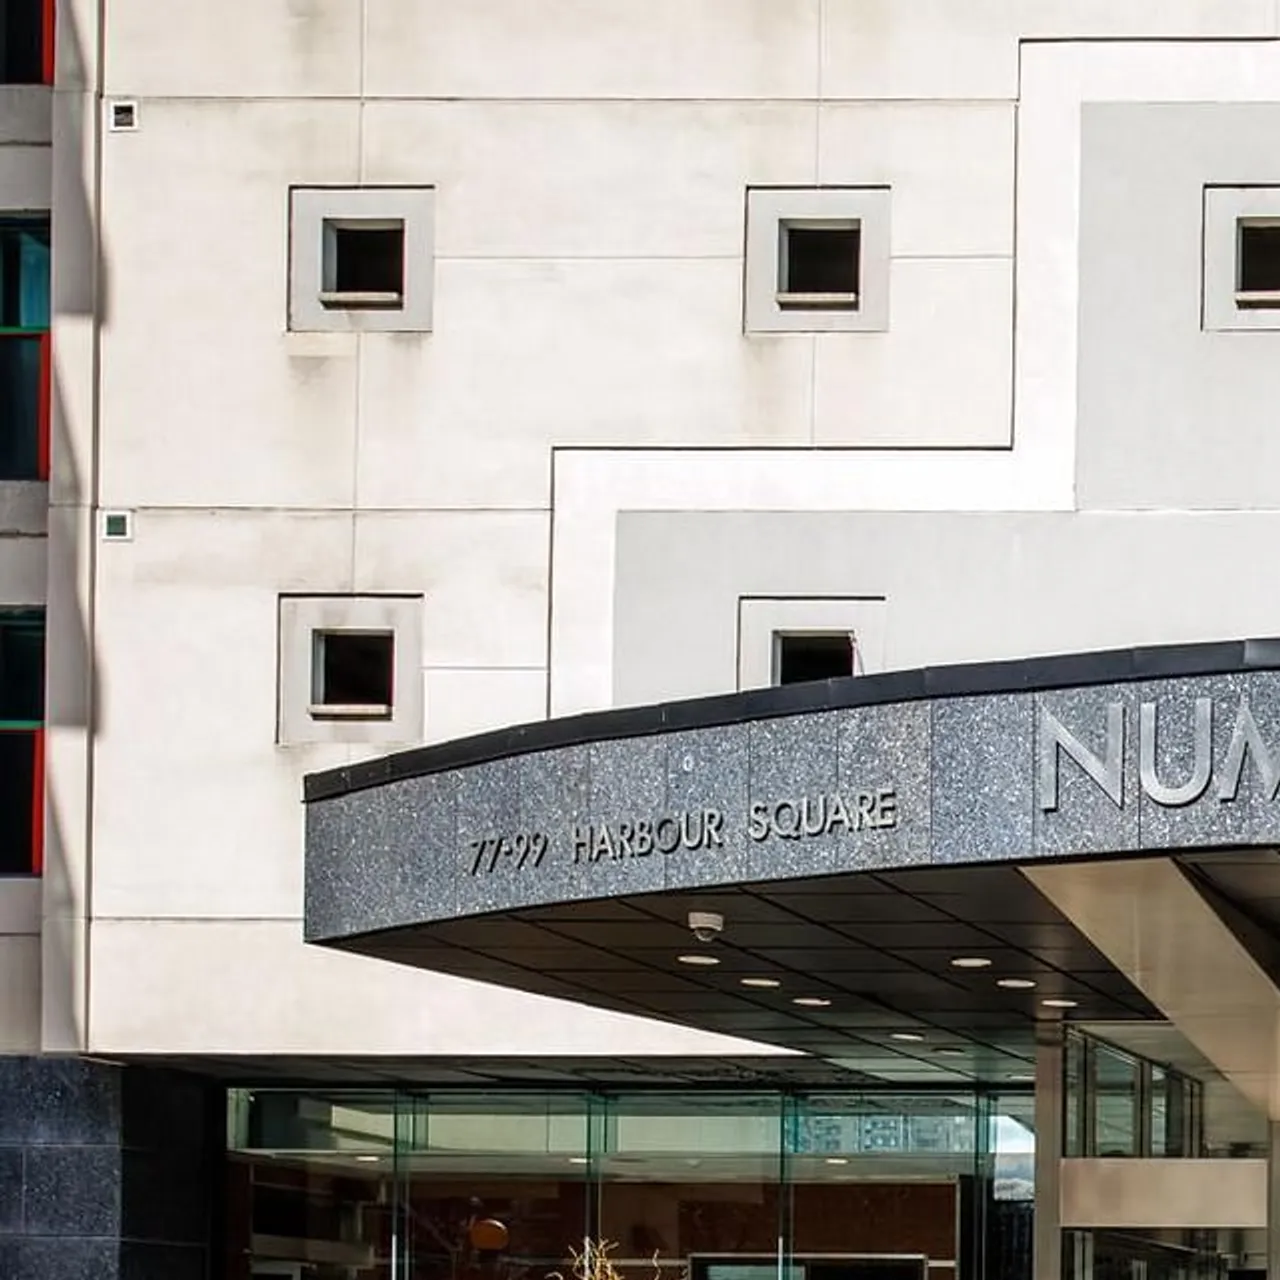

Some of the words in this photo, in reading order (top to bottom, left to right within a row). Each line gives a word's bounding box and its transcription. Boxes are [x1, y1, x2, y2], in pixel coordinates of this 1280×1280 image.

[469, 831, 549, 875] 77-99
[572, 807, 724, 864] HARBOUR
[747, 788, 898, 842] SQUARE
